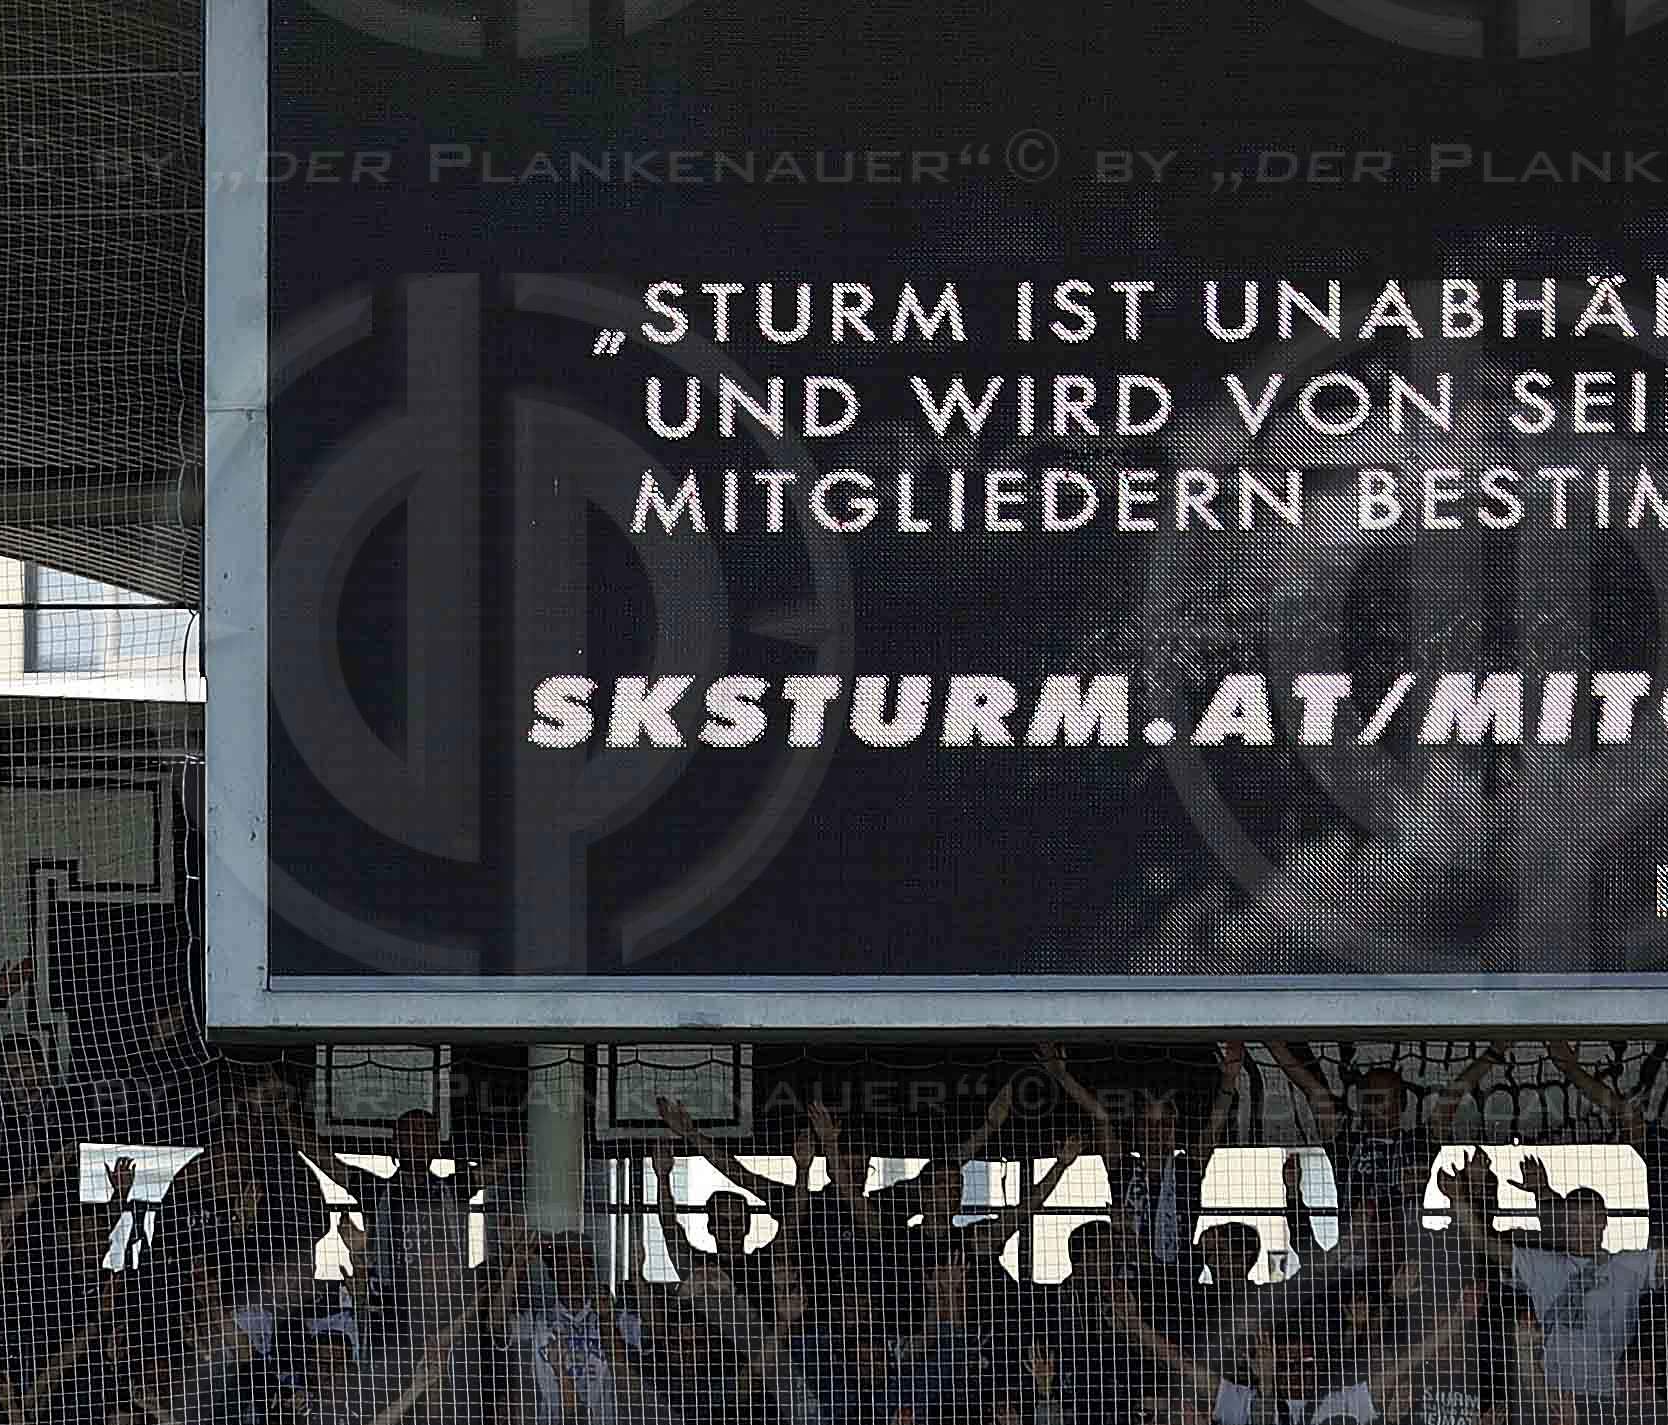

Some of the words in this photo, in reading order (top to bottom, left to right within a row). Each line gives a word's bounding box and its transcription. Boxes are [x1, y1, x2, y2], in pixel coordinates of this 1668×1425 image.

[590, 277, 968, 356] „STURM
[1014, 277, 1146, 343] IST
[644, 372, 860, 440] UND
[907, 370, 1176, 440] WIRD
[1233, 368, 1459, 435] VON
[629, 464, 1303, 536] MITGLIEDERN
